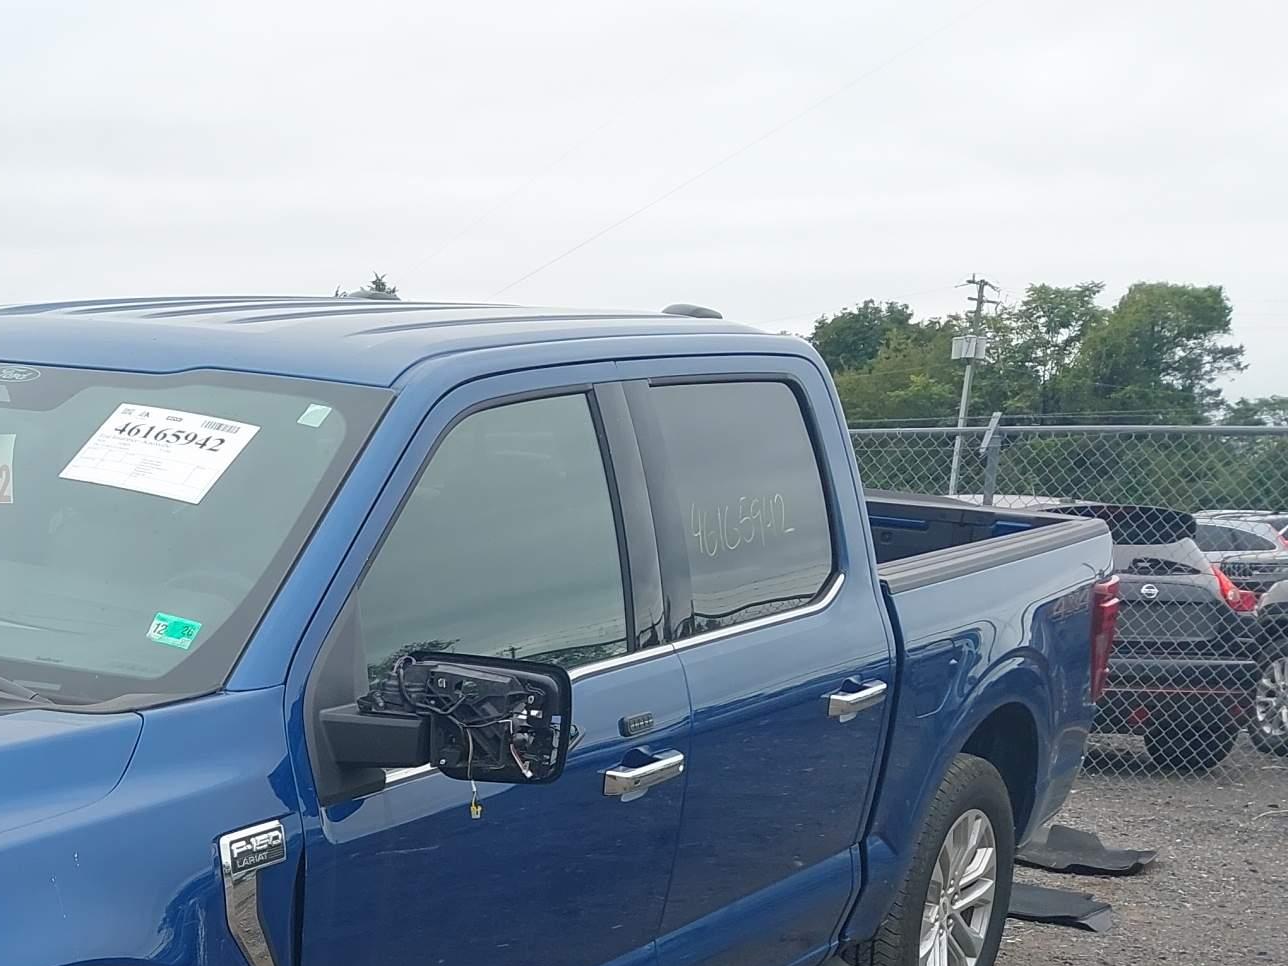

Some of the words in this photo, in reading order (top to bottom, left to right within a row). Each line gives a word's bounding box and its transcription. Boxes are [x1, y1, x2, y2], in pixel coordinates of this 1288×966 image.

[114, 421, 226, 452] 46165942
[152, 623, 168, 636] 12
[231, 830, 282, 858] F-150
[236, 851, 269, 869] LARIAT
